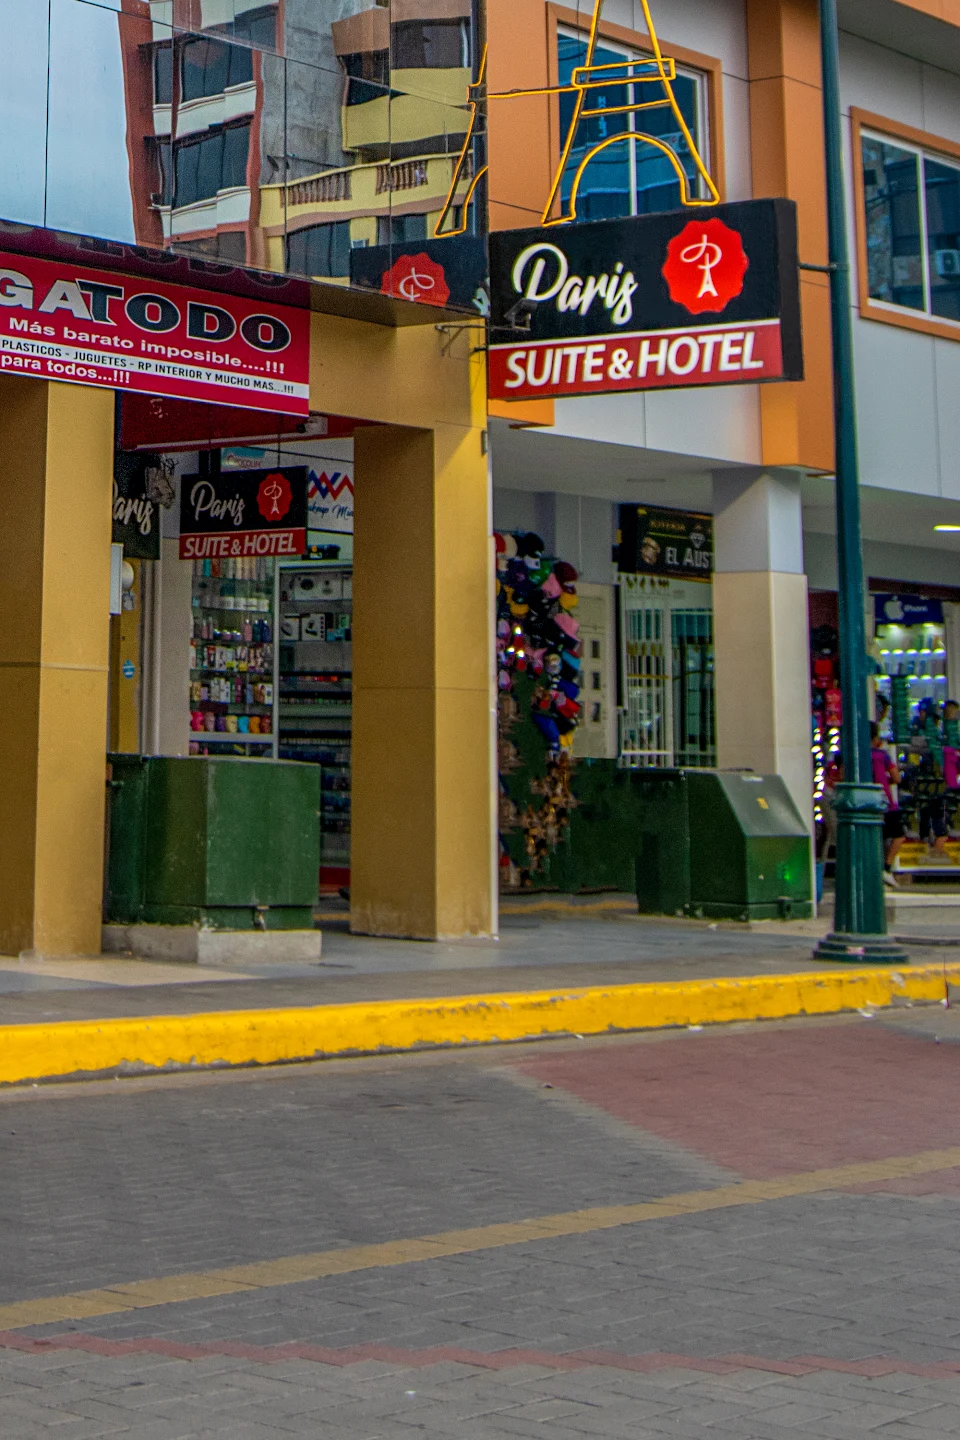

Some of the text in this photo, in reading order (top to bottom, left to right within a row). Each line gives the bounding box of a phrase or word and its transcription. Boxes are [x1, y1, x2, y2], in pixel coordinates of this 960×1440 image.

[512, 242, 639, 325] Paris
[9, 317, 56, 336] Más
[63, 326, 134, 349] barato
[1, 353, 42, 371] para
[2, 339, 62, 357] PLASTICOS
[73, 350, 127, 368] JUGUETES
[138, 360, 152, 371] RP
[155, 363, 202, 380] INTERIOR
[205, 370, 213, 381] Y
[215, 372, 250, 387] MUCHO
[505, 343, 606, 388] SUITE
[637, 331, 764, 378] HOTEL
[190, 480, 246, 526] Paris
[183, 536, 230, 557] SUITE
[243, 532, 297, 555] HOTEL
[665, 547, 680, 565] EL
